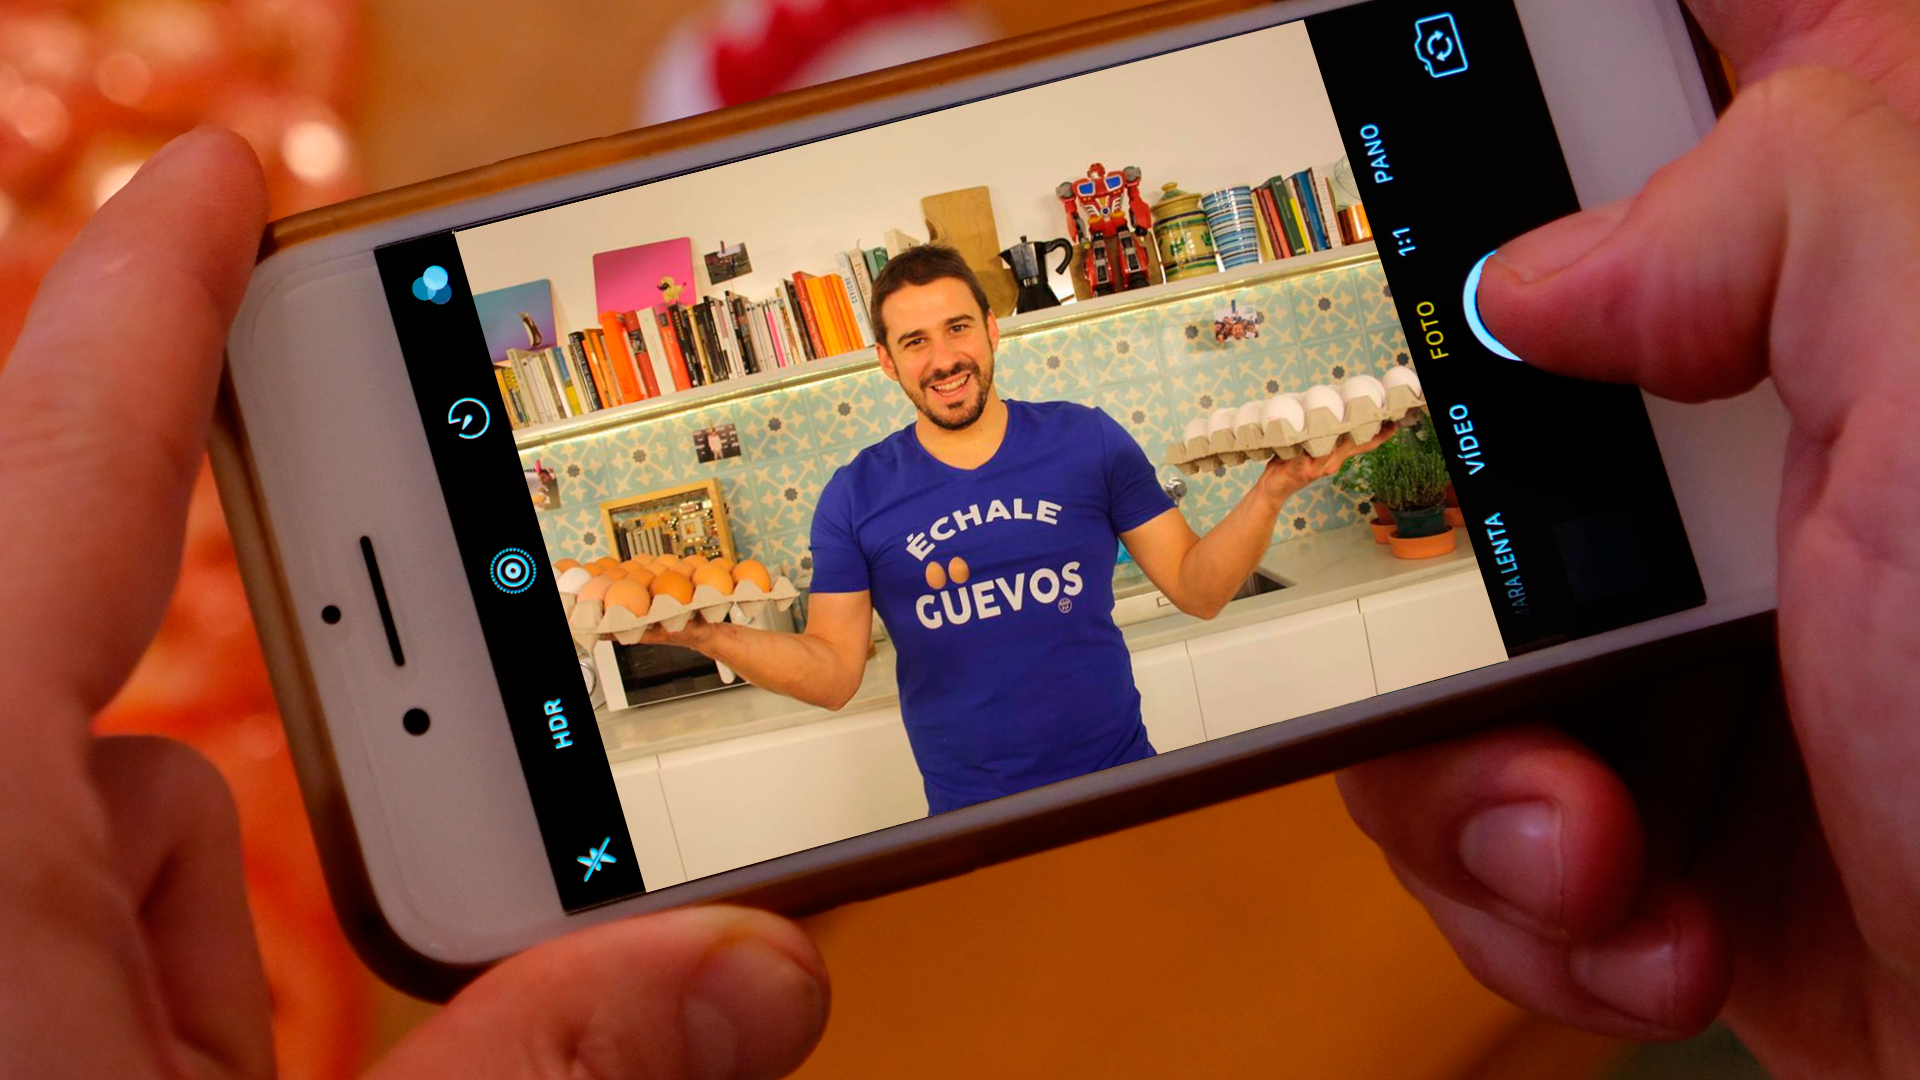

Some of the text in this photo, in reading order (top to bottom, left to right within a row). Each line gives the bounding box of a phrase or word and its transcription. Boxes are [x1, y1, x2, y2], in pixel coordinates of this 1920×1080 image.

[1360, 124, 1394, 184] PANO
[1392, 227, 1416, 257] 1:1
[1416, 301, 1449, 360] FOTO
[1449, 404, 1485, 475] VÍDEO
[906, 498, 1062, 561] ÉCHALE
[1484, 512, 1519, 574] LENTA
[543, 698, 574, 750] HDR
